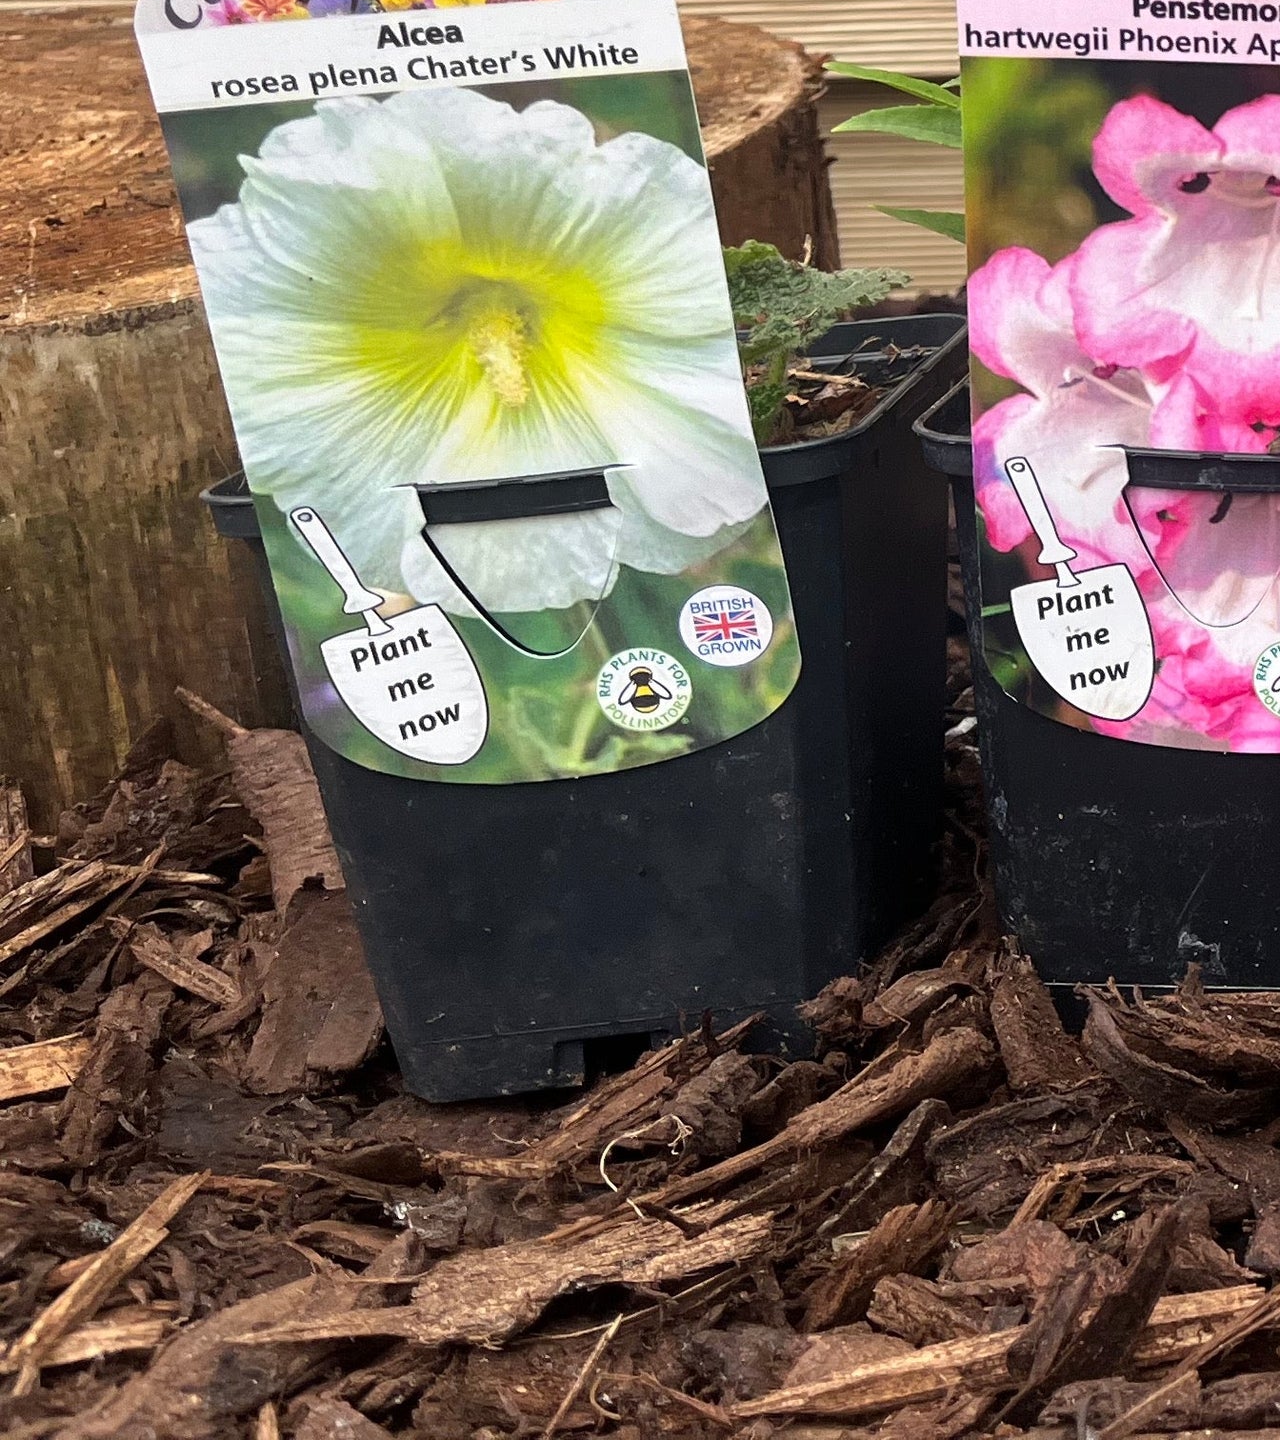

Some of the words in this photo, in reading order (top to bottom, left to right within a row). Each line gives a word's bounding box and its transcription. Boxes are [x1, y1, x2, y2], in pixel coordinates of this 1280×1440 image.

[377, 22, 463, 49] Alcea
[965, 24, 1108, 56] hartwegii
[1119, 28, 1237, 57] Phoenix
[211, 73, 298, 100] rosea
[309, 62, 395, 95] plena
[408, 49, 536, 80] Chater's
[544, 42, 639, 71] White
[690, 598, 753, 613] BRITISH
[1037, 584, 1114, 620] Plant
[351, 628, 431, 672] Plant
[698, 639, 761, 655] GROWN
[1066, 628, 1110, 652] me
[600, 672, 613, 697] RHS
[611, 651, 667, 670] PLANTS
[668, 663, 687, 688] FOR
[1070, 661, 1129, 690] now
[1256, 657, 1271, 681] RHS
[388, 672, 435, 701] me
[399, 703, 460, 740] now
[605, 693, 687, 728] POLLINATORS
